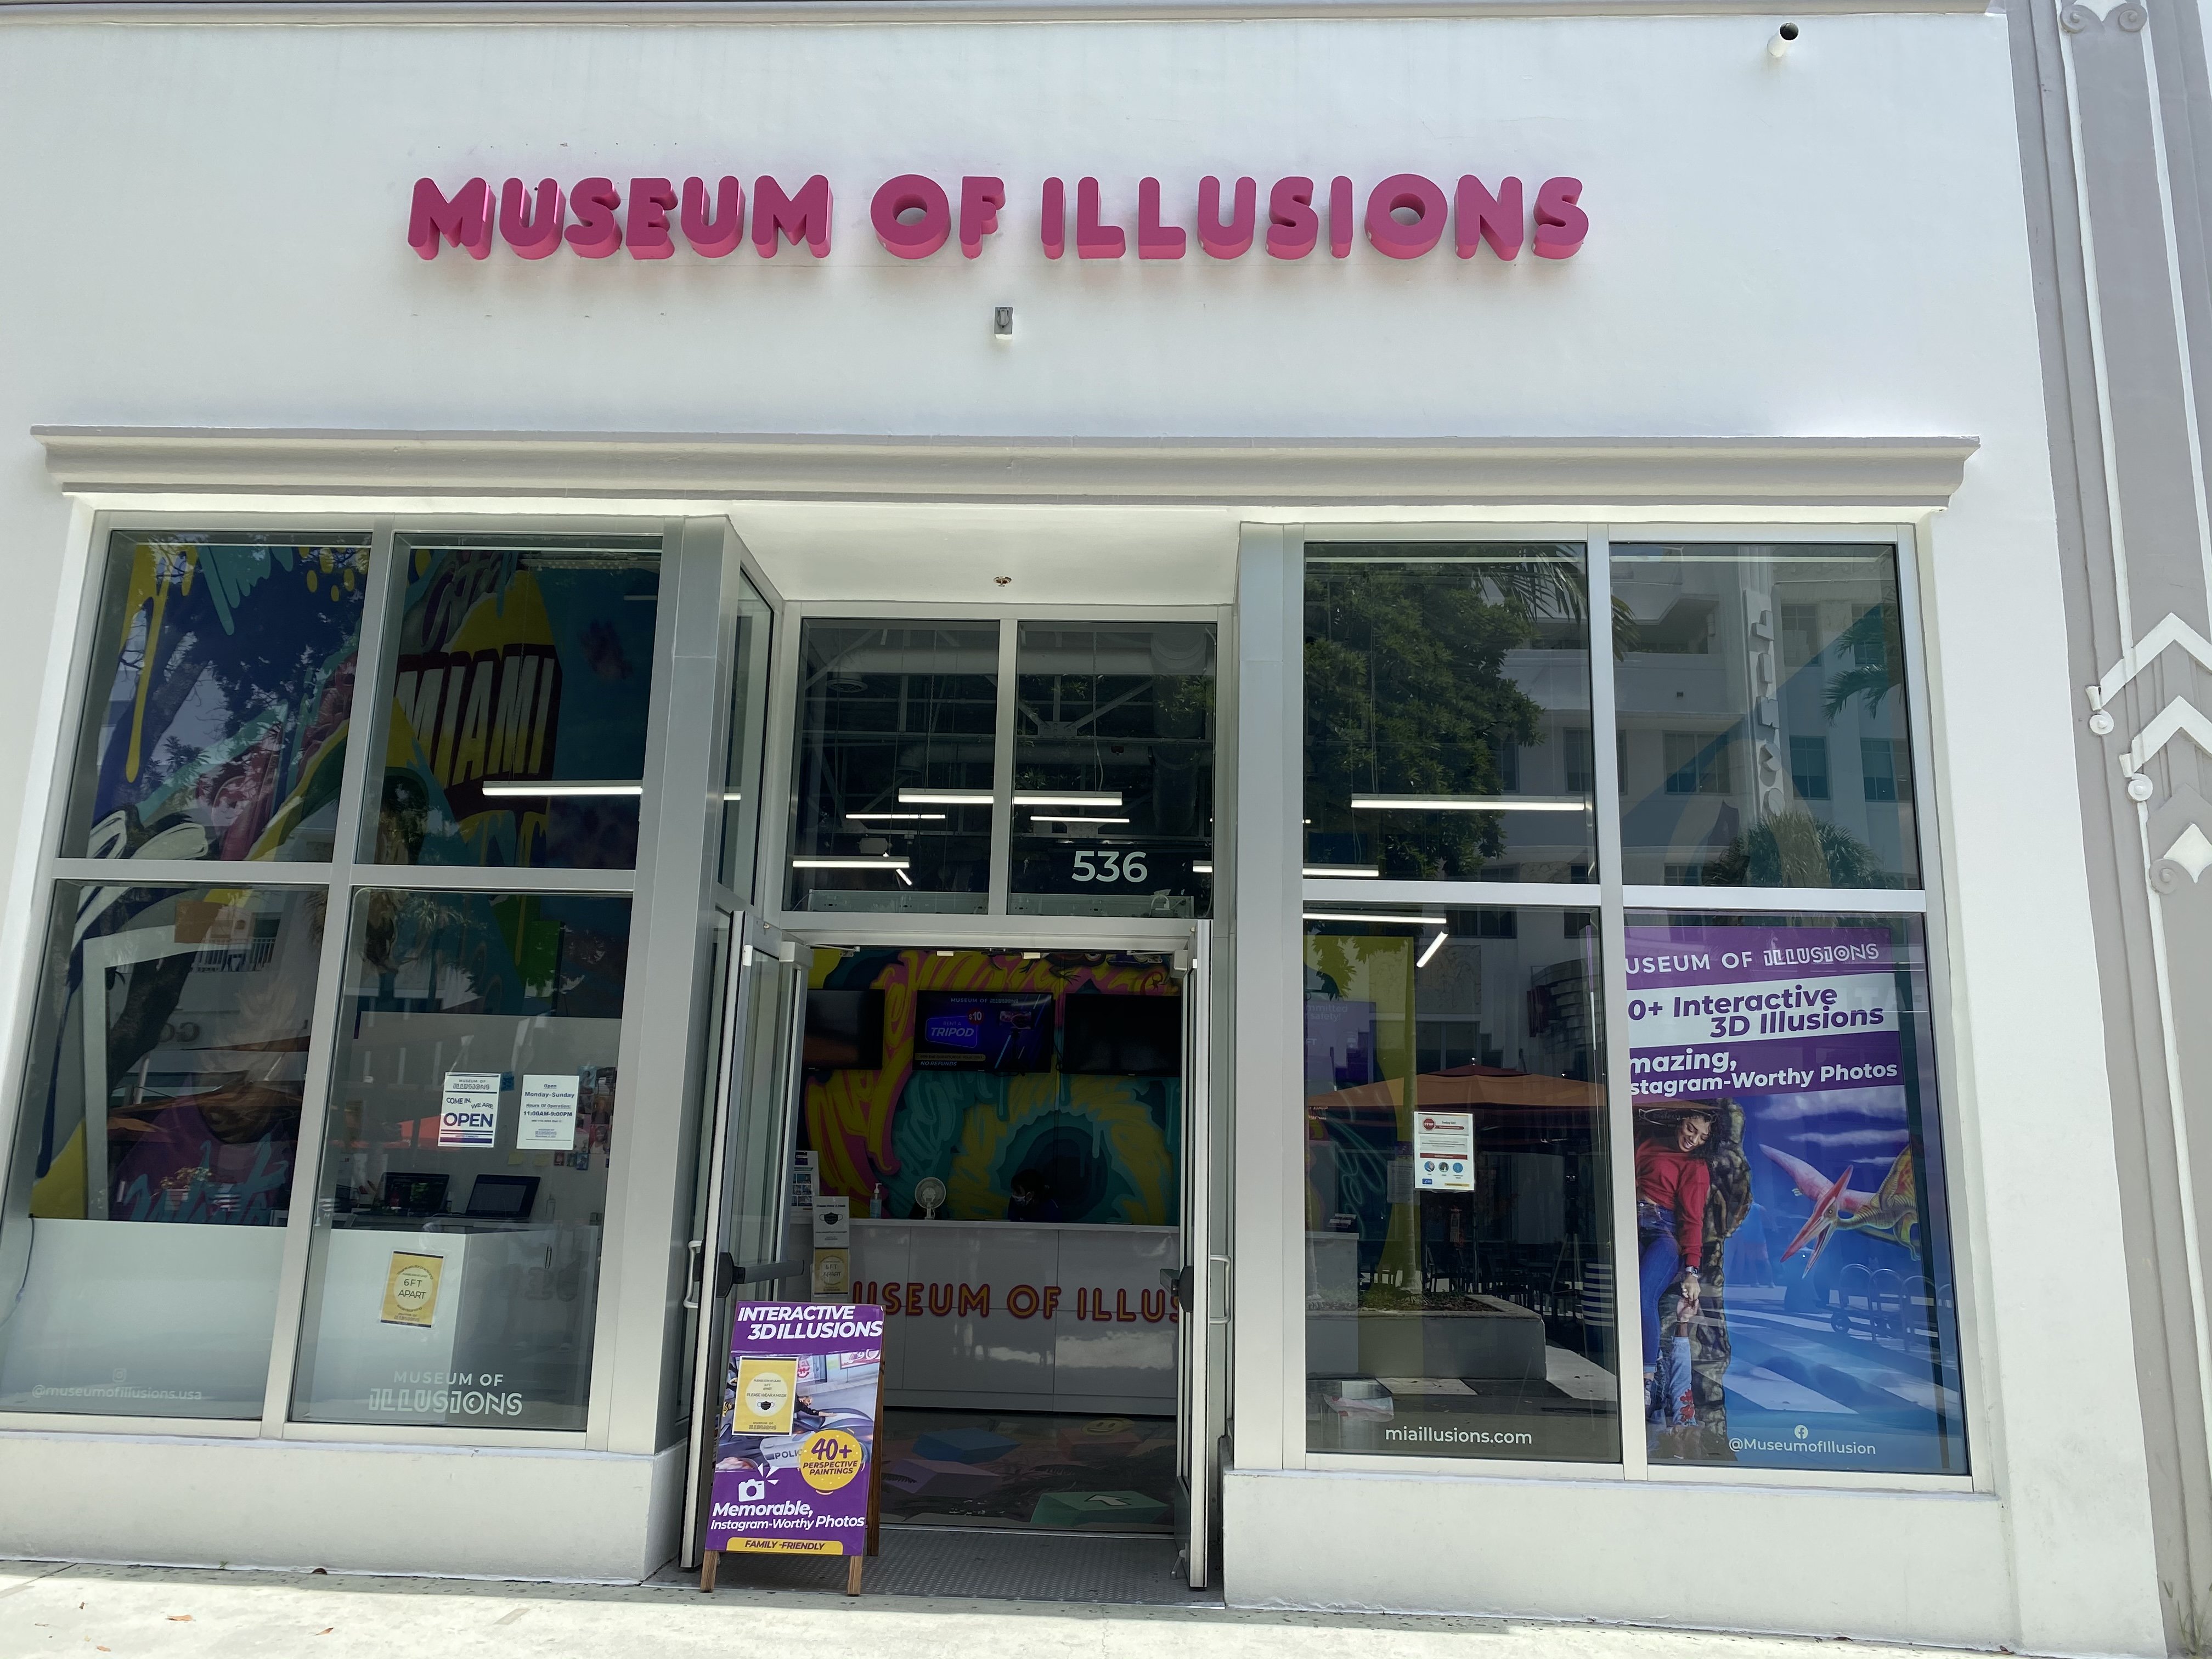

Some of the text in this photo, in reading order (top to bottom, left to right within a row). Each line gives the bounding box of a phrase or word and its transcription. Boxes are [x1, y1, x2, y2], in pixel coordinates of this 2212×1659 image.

[408, 173, 1589, 261] MUSEUM OF ILLUSIONS
[395, 654, 556, 789] MIAMI
[1071, 850, 1148, 883] 536
[1722, 951, 1753, 969] OF
[1763, 943, 1880, 967] ILLUSIONS
[1673, 984, 1837, 1018] Interactive
[968, 1011, 982, 1021] $10
[1709, 1006, 1884, 1039] 3D Illusions
[930, 1028, 974, 1037] TRIPOD
[1629, 1048, 1737, 1074] mazing,
[1820, 1062, 1898, 1082] Photos
[443, 1112, 493, 1127] OPEN
[397, 1289, 427, 1300] APART
[1007, 1284, 1062, 1319] OF
[737, 1305, 856, 1322] INTERACTIVE
[394, 1371, 503, 1386] MUSEUM OF
[32, 1384, 202, 1400] @museumofillusions.usa
[368, 1388, 522, 1416] ILLUSIONS
[1385, 1425, 1533, 1445] miaillusions.com
[811, 1438, 853, 1460] 40+
[1728, 1437, 1876, 1455] @MuseumofIllusion
[803, 1460, 858, 1469] PERSPECTIVE
[809, 1468, 853, 1476] PAINTINGS
[712, 1500, 814, 1518] Memorable,
[710, 1515, 865, 1532] Instagram-Worthy Photos
